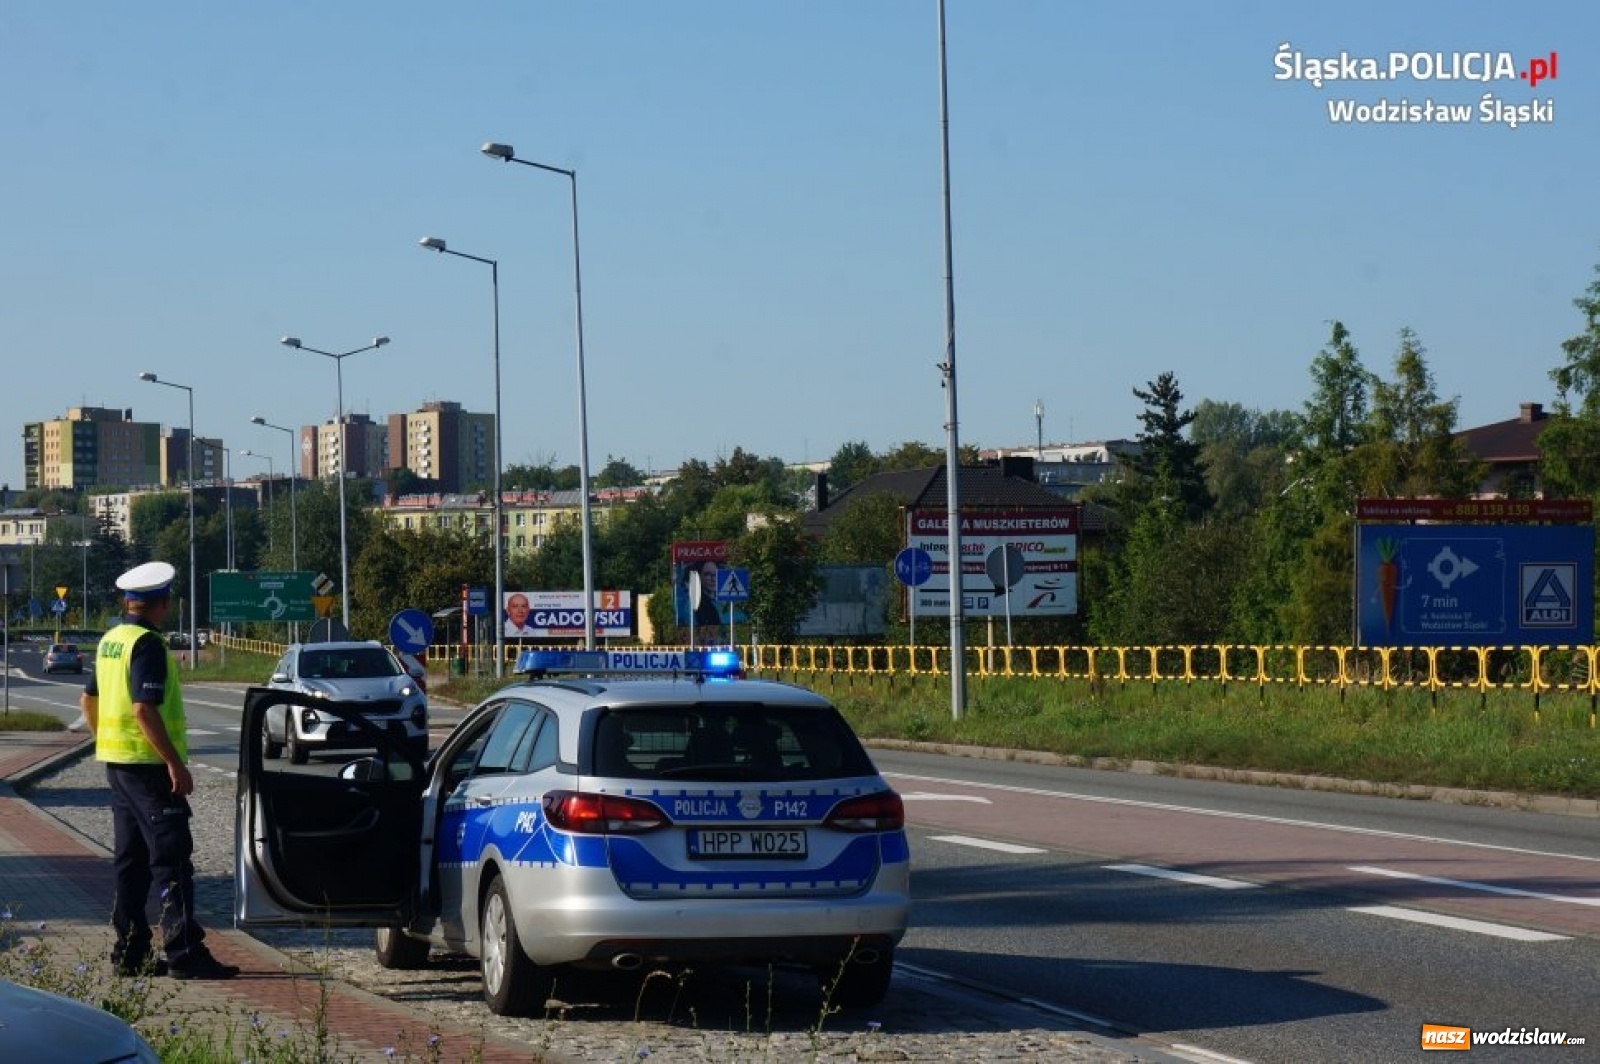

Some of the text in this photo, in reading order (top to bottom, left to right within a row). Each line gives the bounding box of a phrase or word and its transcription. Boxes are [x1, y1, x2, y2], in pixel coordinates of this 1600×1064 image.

[918, 517, 1069, 529] GALEA MUSZKIETERÓW
[605, 594, 616, 610] 2
[1421, 594, 1459, 608] 7 min
[1531, 609, 1567, 621] ALDI
[613, 652, 682, 669] POLICJA
[674, 800, 729, 816] POLICJA
[774, 801, 809, 816] P142
[703, 832, 801, 852] HPP W025
